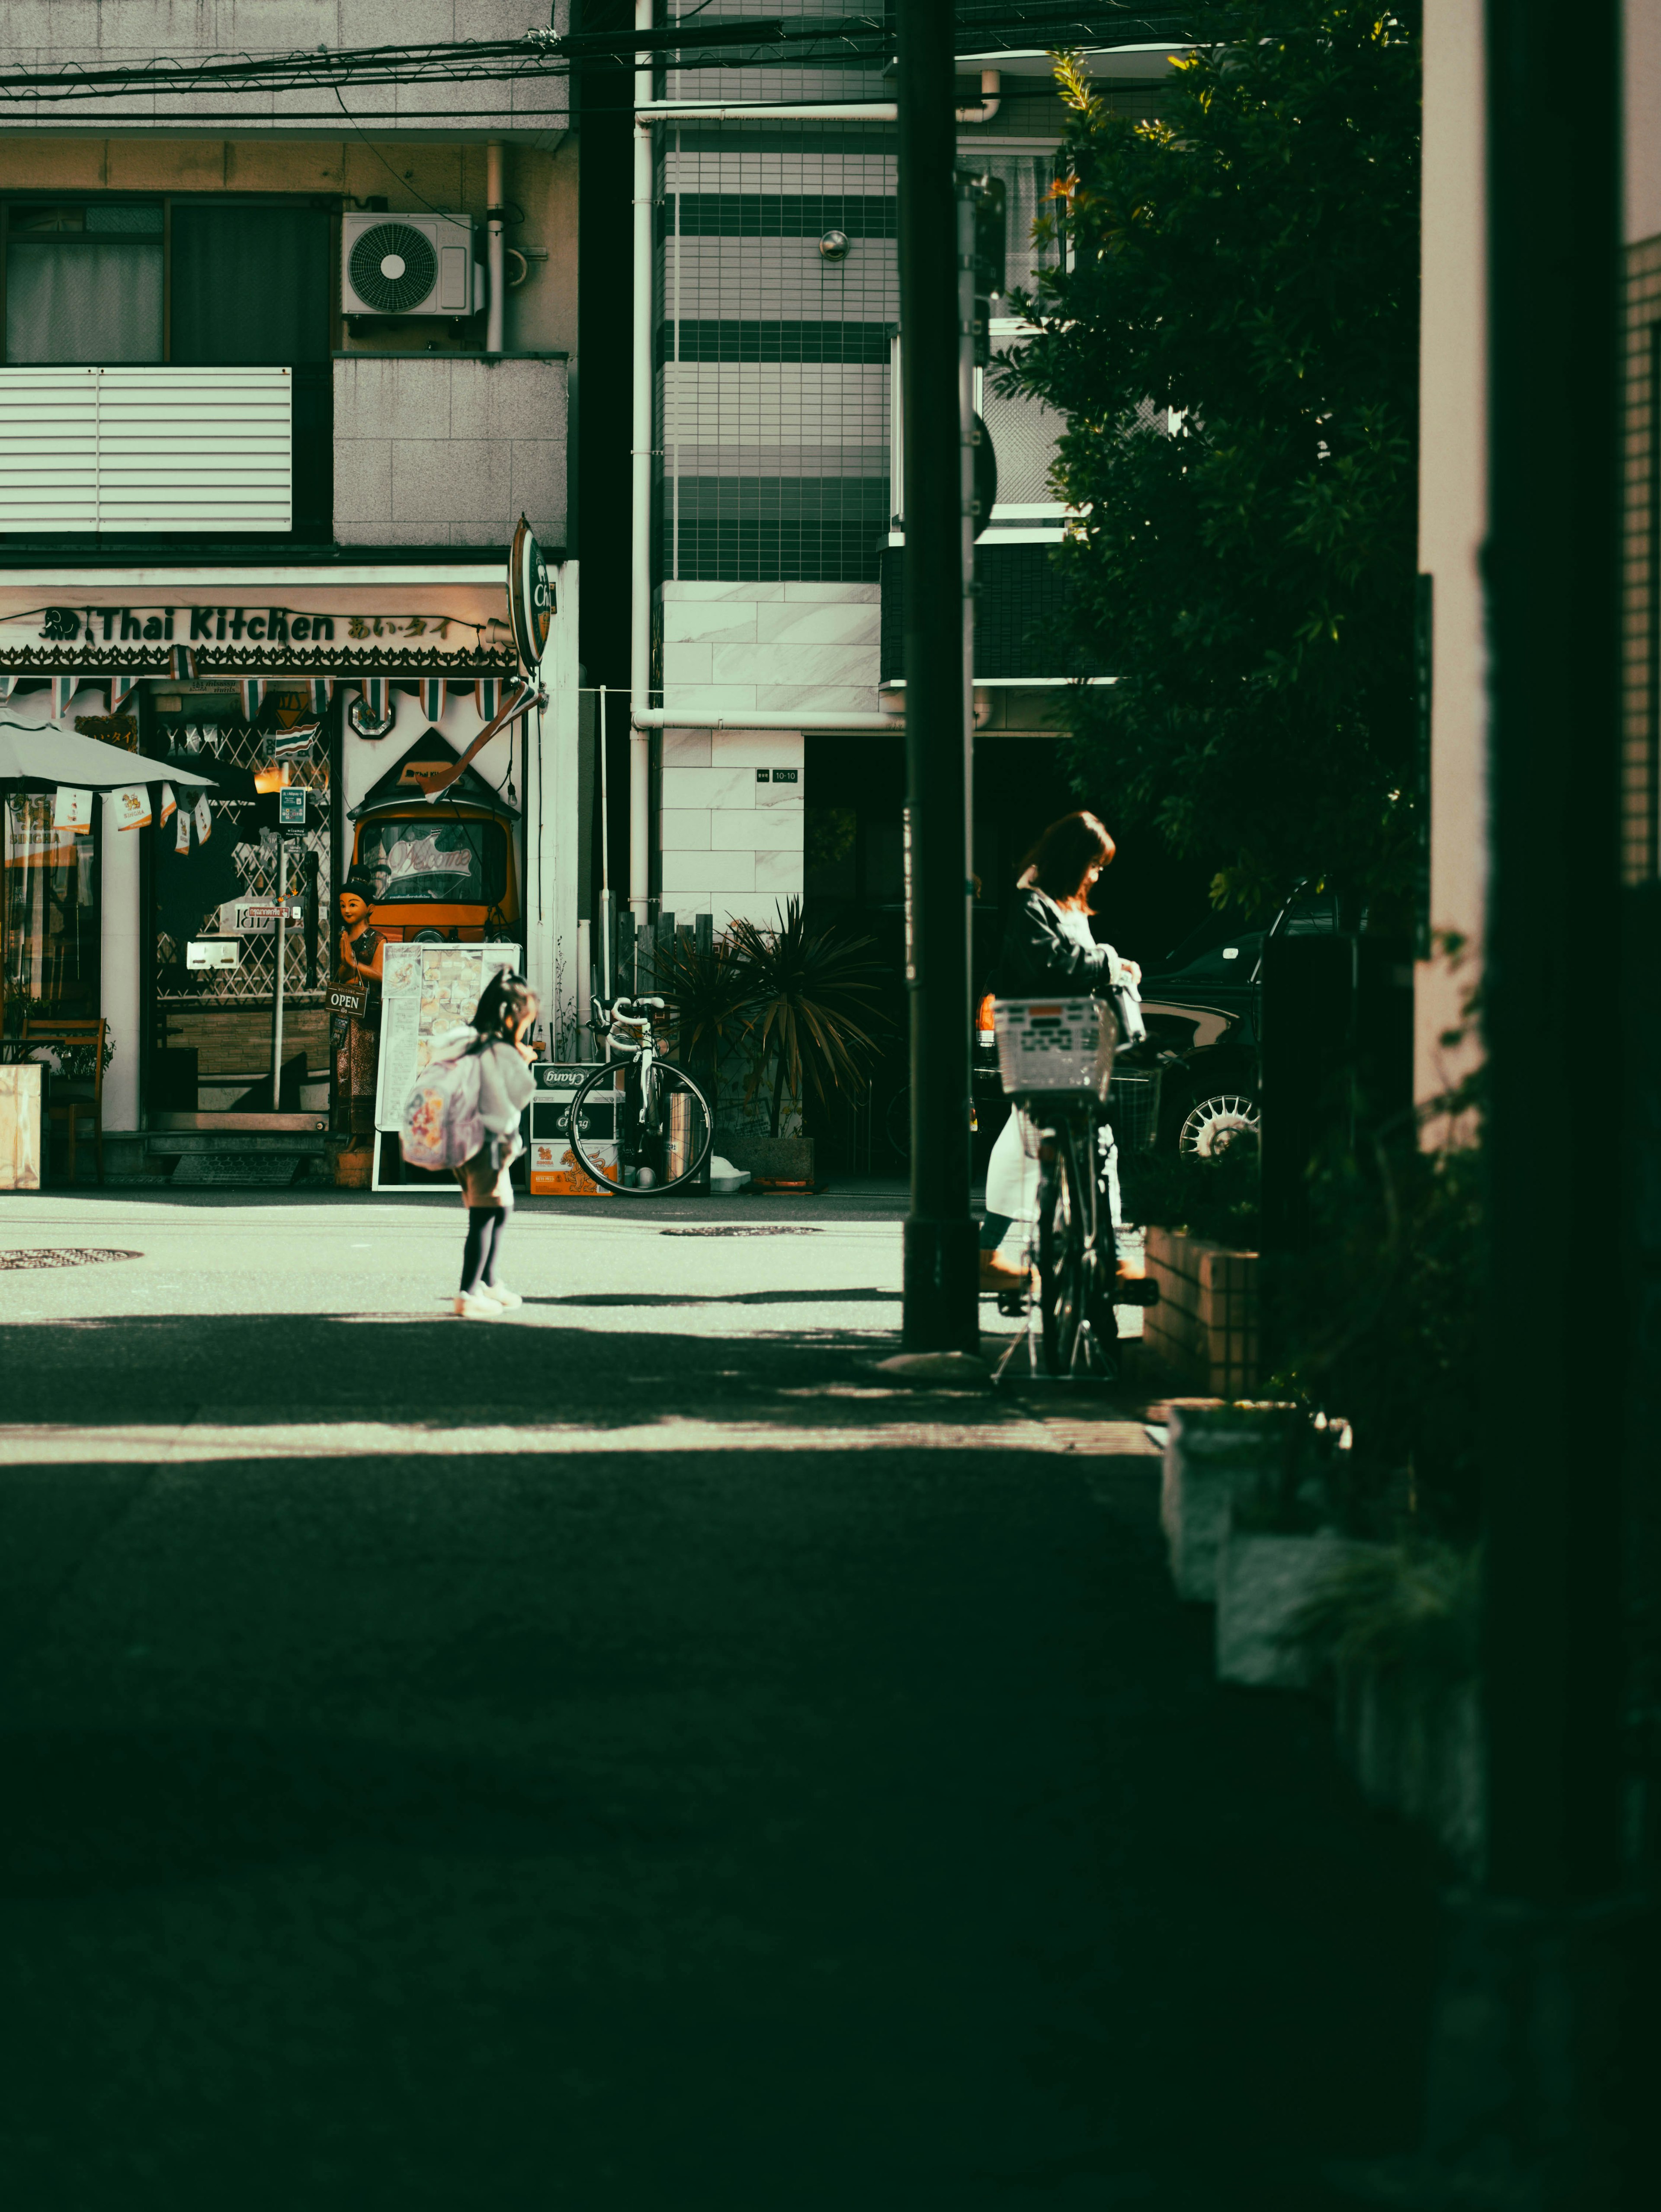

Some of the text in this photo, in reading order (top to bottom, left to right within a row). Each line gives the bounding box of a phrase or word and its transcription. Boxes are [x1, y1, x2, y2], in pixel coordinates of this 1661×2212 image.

[96, 608, 335, 640] Thai Kitchen
[348, 617, 451, 640] あい・タイ
[124, 809, 145, 819] SINGHA
[10, 833, 61, 844] SINGHA
[388, 841, 471, 872] Welcome
[331, 994, 359, 1009] OPEN
[546, 1071, 584, 1085] Chang
